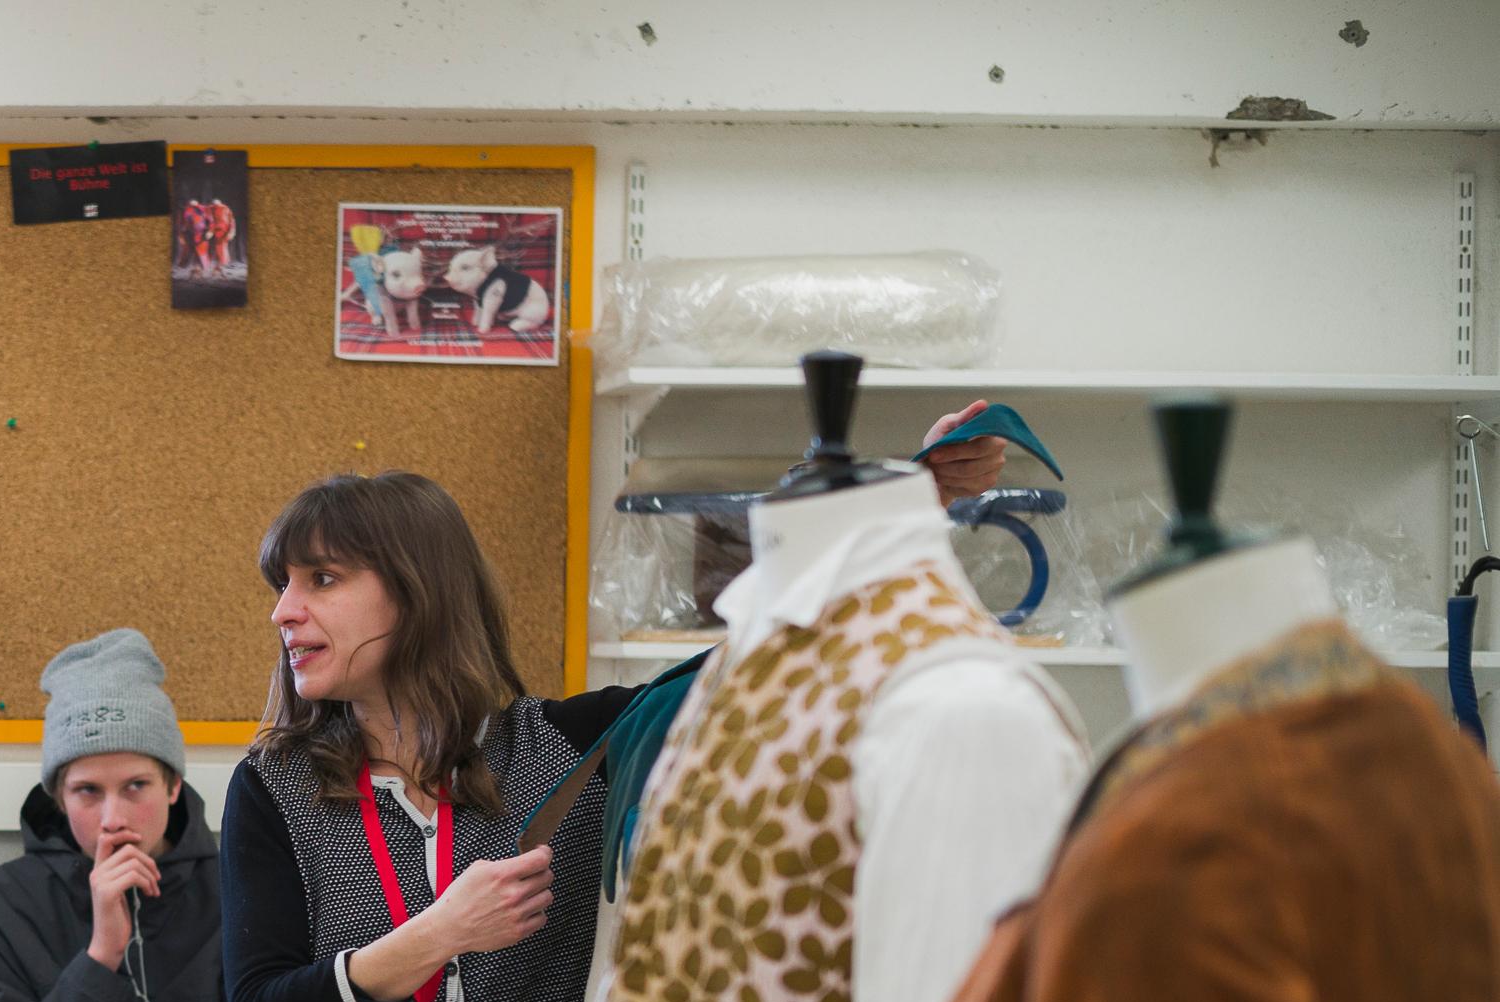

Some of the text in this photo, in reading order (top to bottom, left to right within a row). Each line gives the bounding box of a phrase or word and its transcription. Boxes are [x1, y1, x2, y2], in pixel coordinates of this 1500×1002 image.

[29, 162, 149, 181] Die ganze Welt ist
[68, 178, 111, 191] Bühne
